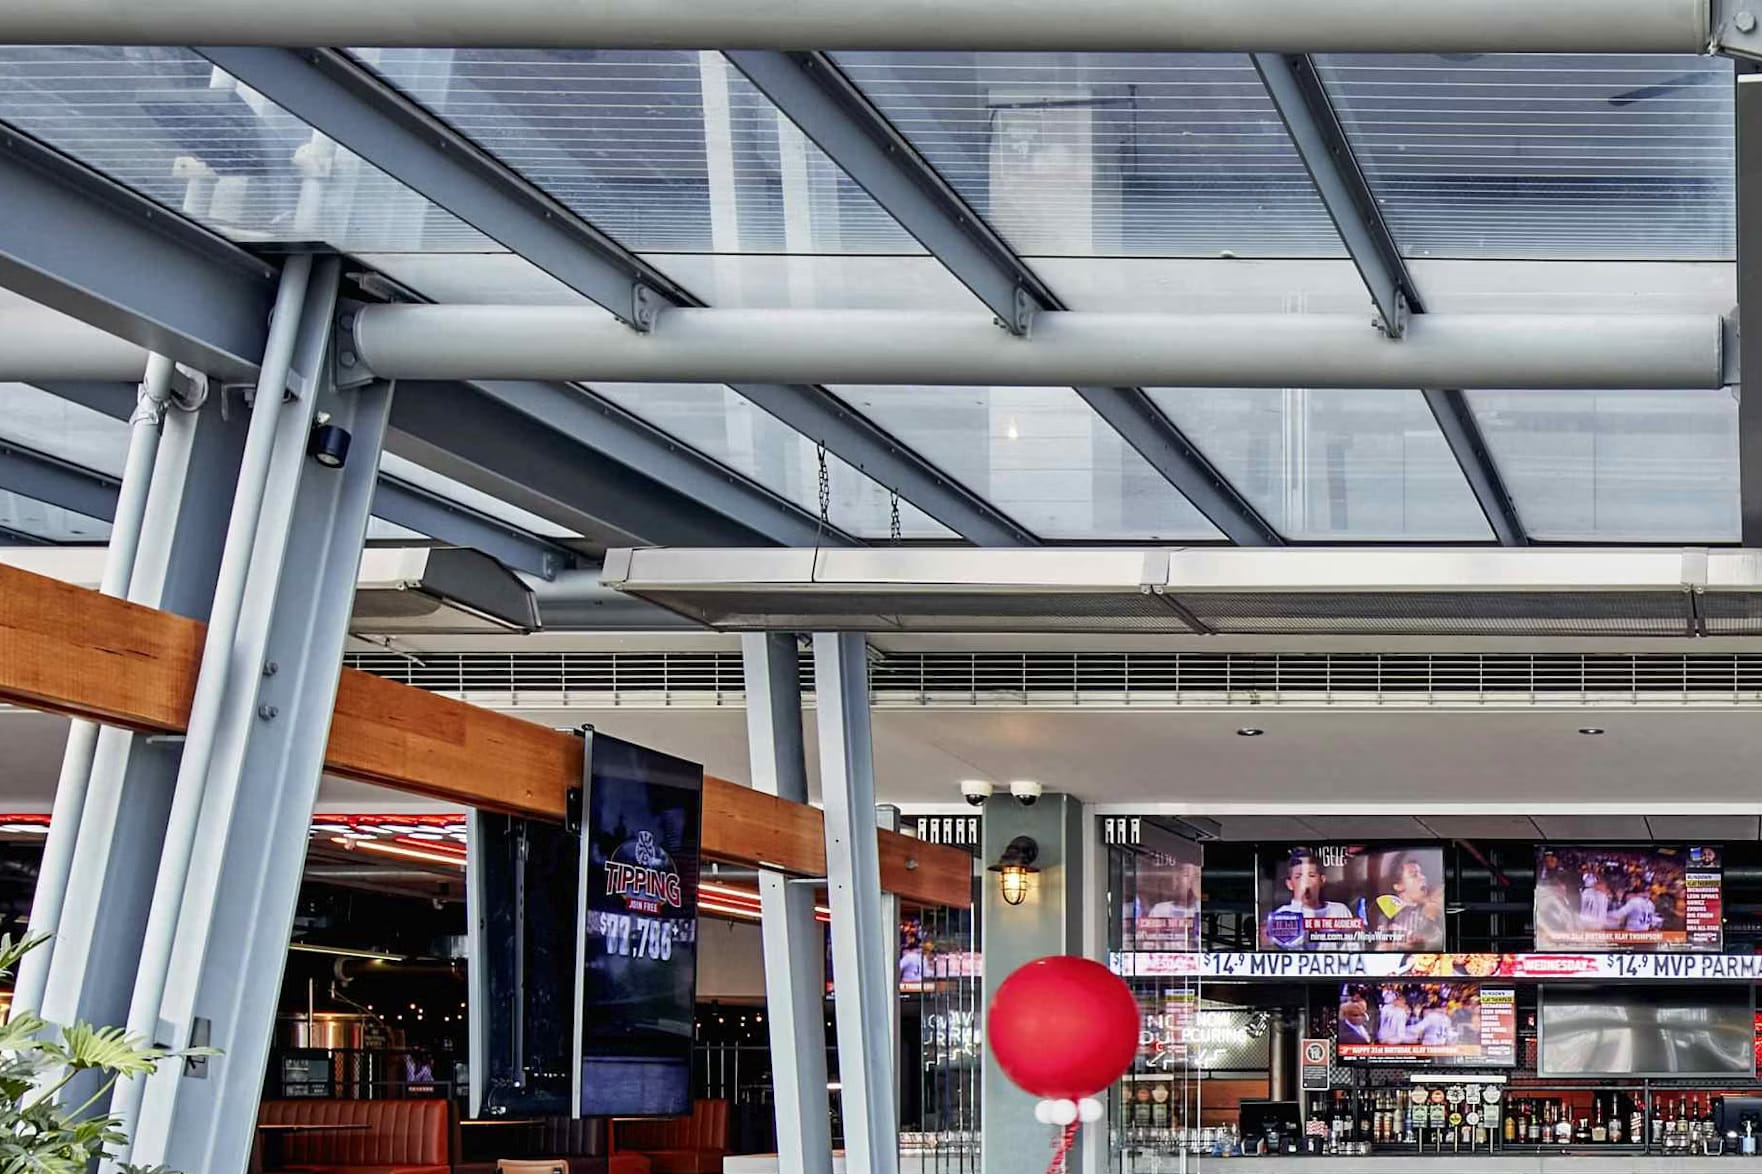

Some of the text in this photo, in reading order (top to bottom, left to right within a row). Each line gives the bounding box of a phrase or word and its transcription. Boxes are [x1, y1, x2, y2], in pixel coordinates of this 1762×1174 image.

[605, 861, 681, 908] TIPPING
[629, 900, 658, 913] JOIN FREE
[1304, 919, 1313, 929] BE
[1314, 919, 1320, 929] IN
[1321, 919, 1332, 929] THE
[1333, 919, 1362, 929] AUDIENCE
[1250, 954, 1292, 975] MVP
[1298, 954, 1366, 975] PARMA
[1523, 959, 1588, 971] WEDNESDAY
[1654, 956, 1696, 976] MVP
